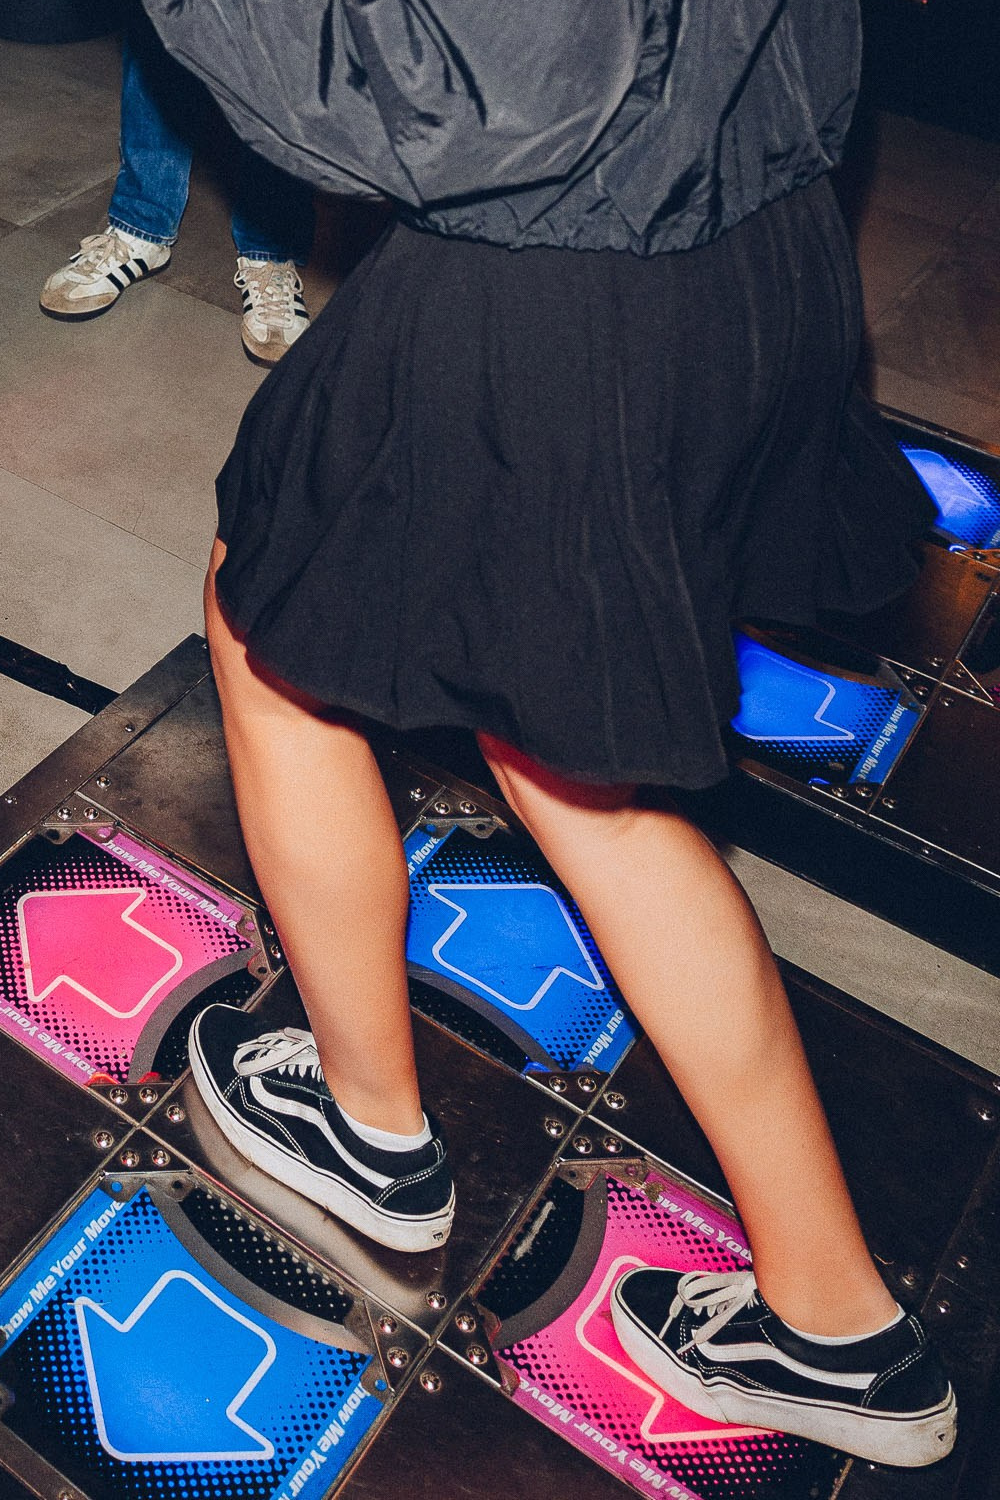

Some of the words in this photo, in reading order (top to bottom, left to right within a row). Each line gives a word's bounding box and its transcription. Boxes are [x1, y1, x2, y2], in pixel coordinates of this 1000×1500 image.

[881, 721, 898, 737] Me
[871, 735, 891, 758] Your
[102, 839, 138, 863] how
[135, 860, 161, 879] Me
[160, 874, 199, 901] Your
[0, 1007, 39, 1037] Your
[606, 1009, 625, 1035] our
[37, 1031, 66, 1055] Me
[680, 1209, 715, 1236] Me
[716, 1229, 753, 1263] You
[0, 1298, 34, 1340] how
[29, 1274, 57, 1304] Me
[50, 1237, 87, 1277] Your
[338, 1381, 372, 1425] how
[317, 1419, 346, 1453] Me
[574, 1421, 629, 1465] Your
[289, 1449, 327, 1498] Your
[629, 1458, 668, 1490] Me
